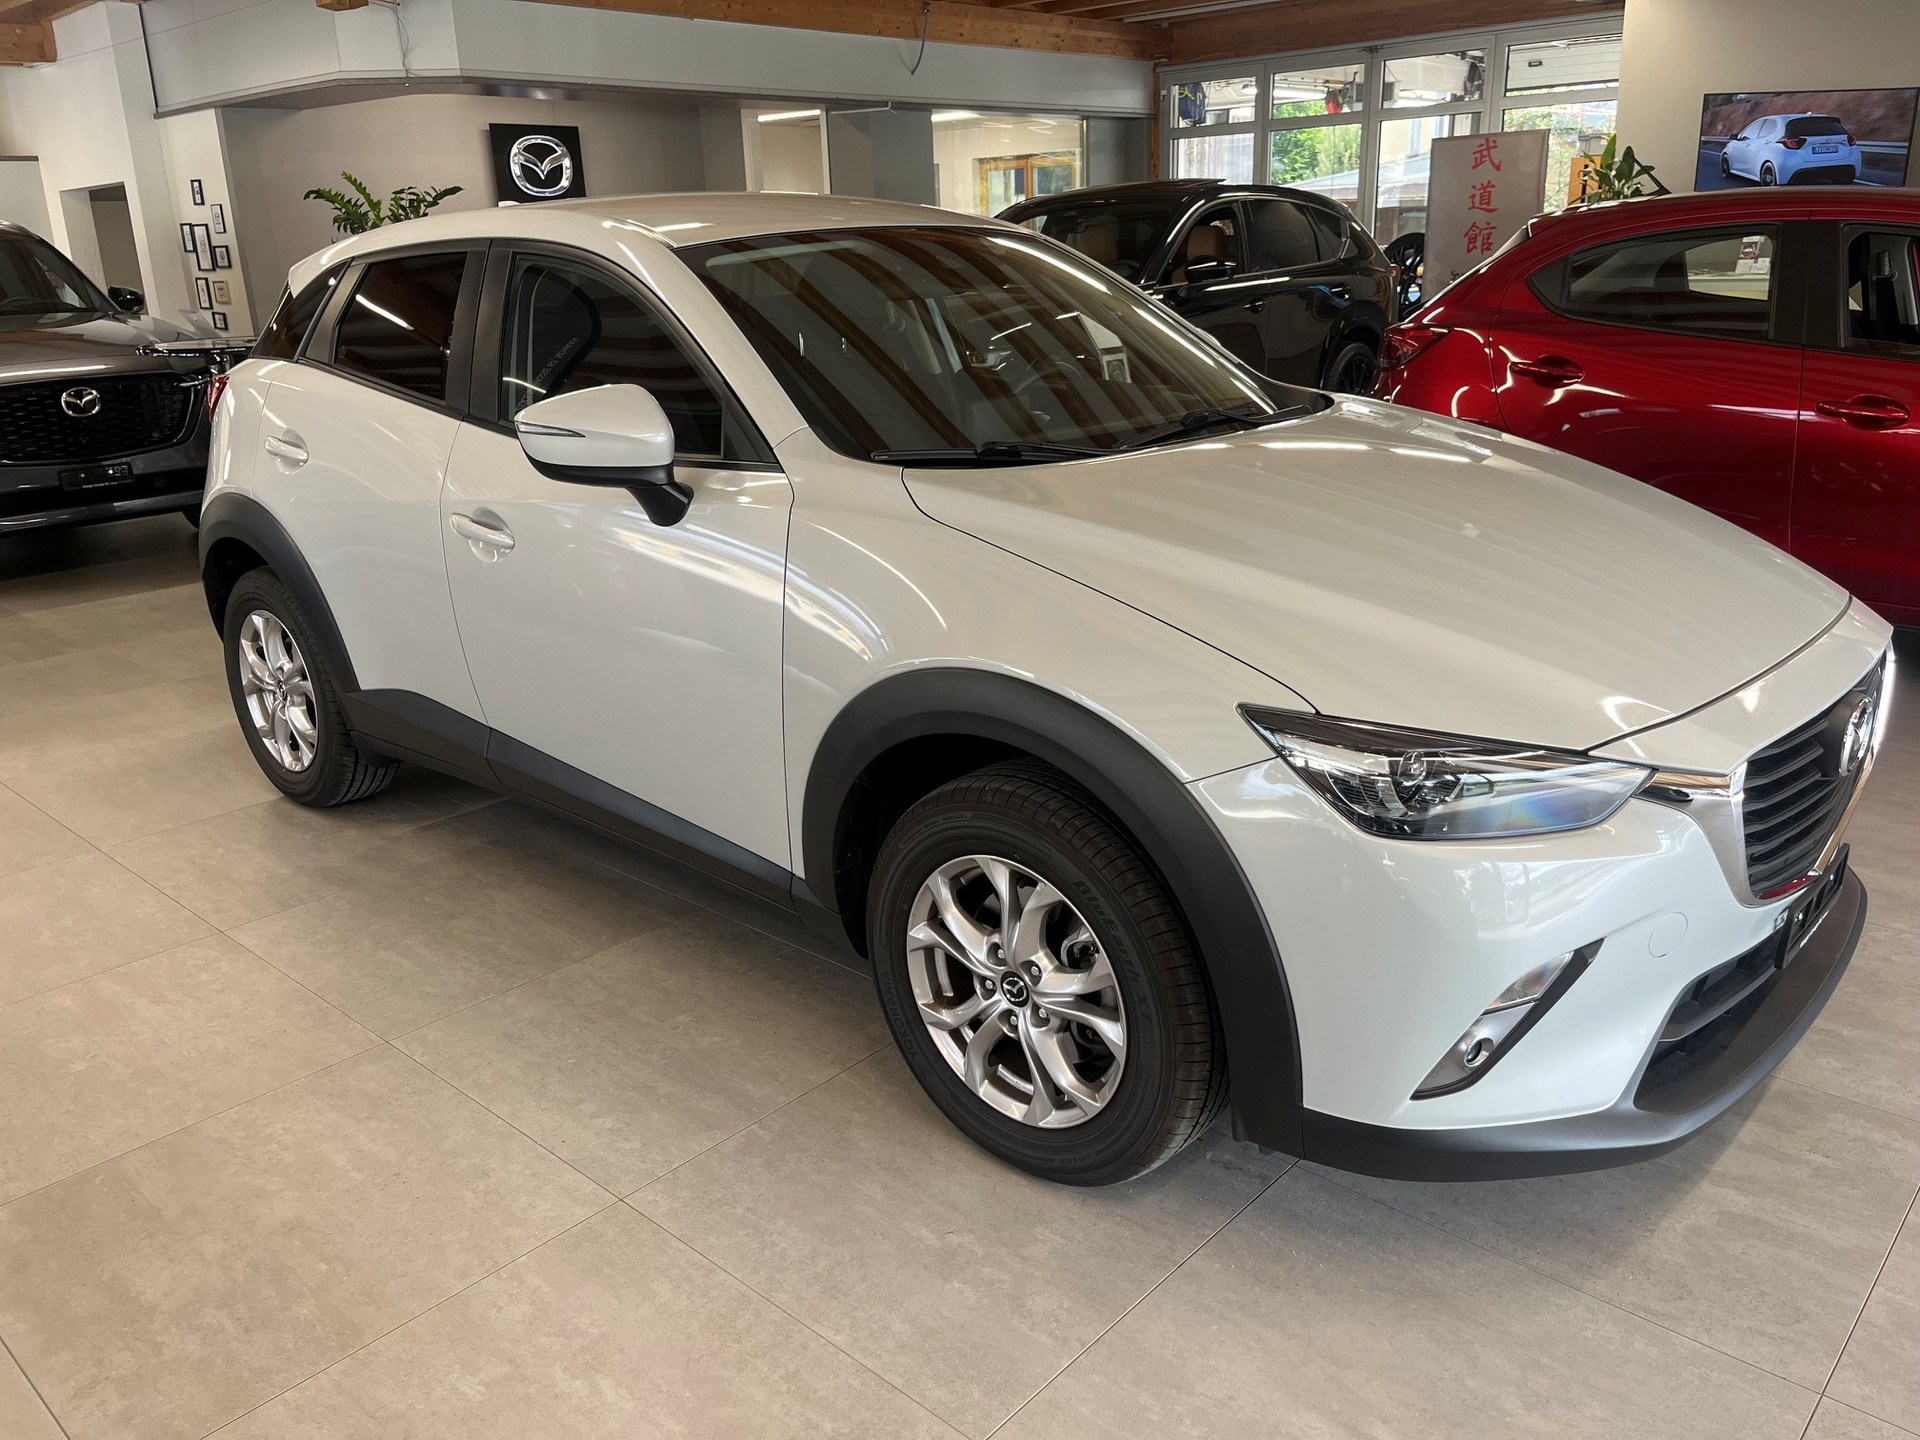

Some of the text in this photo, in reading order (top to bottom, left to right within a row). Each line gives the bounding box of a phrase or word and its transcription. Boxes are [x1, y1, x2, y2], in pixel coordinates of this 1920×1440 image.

[1463, 138, 1502, 255] 武道館
[880, 970, 918, 1060] YOKOHAMA
